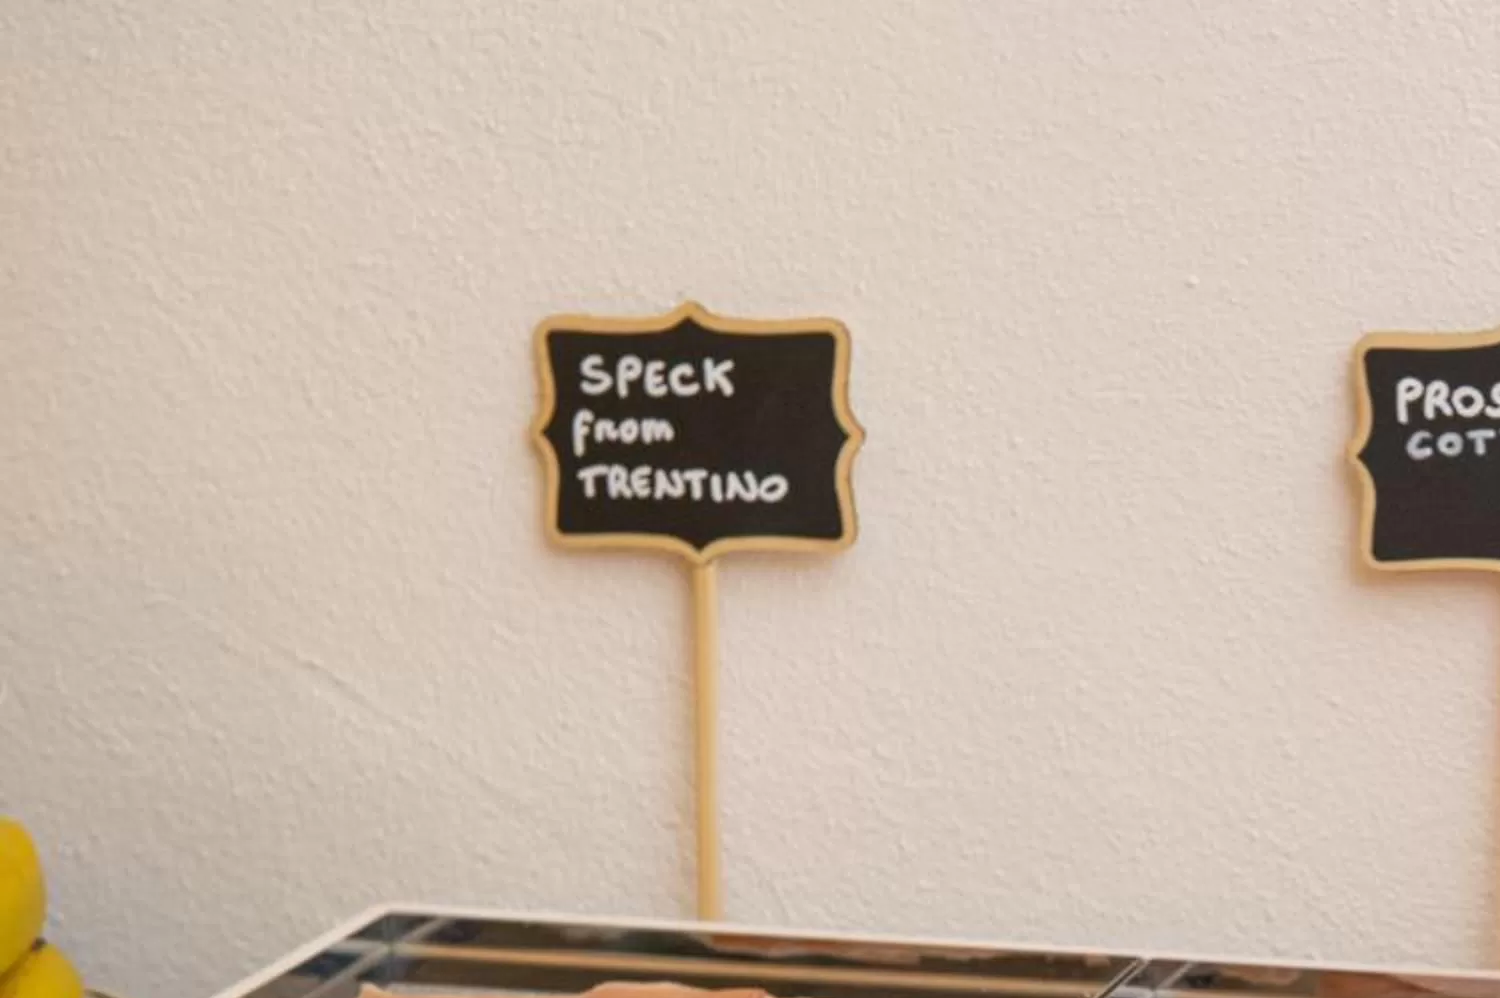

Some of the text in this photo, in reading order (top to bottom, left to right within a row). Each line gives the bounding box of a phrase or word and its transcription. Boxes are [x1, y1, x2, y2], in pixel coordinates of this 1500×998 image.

[580, 354, 735, 399] SPECK
[572, 408, 676, 457] from
[576, 463, 790, 503] TRENTINO
